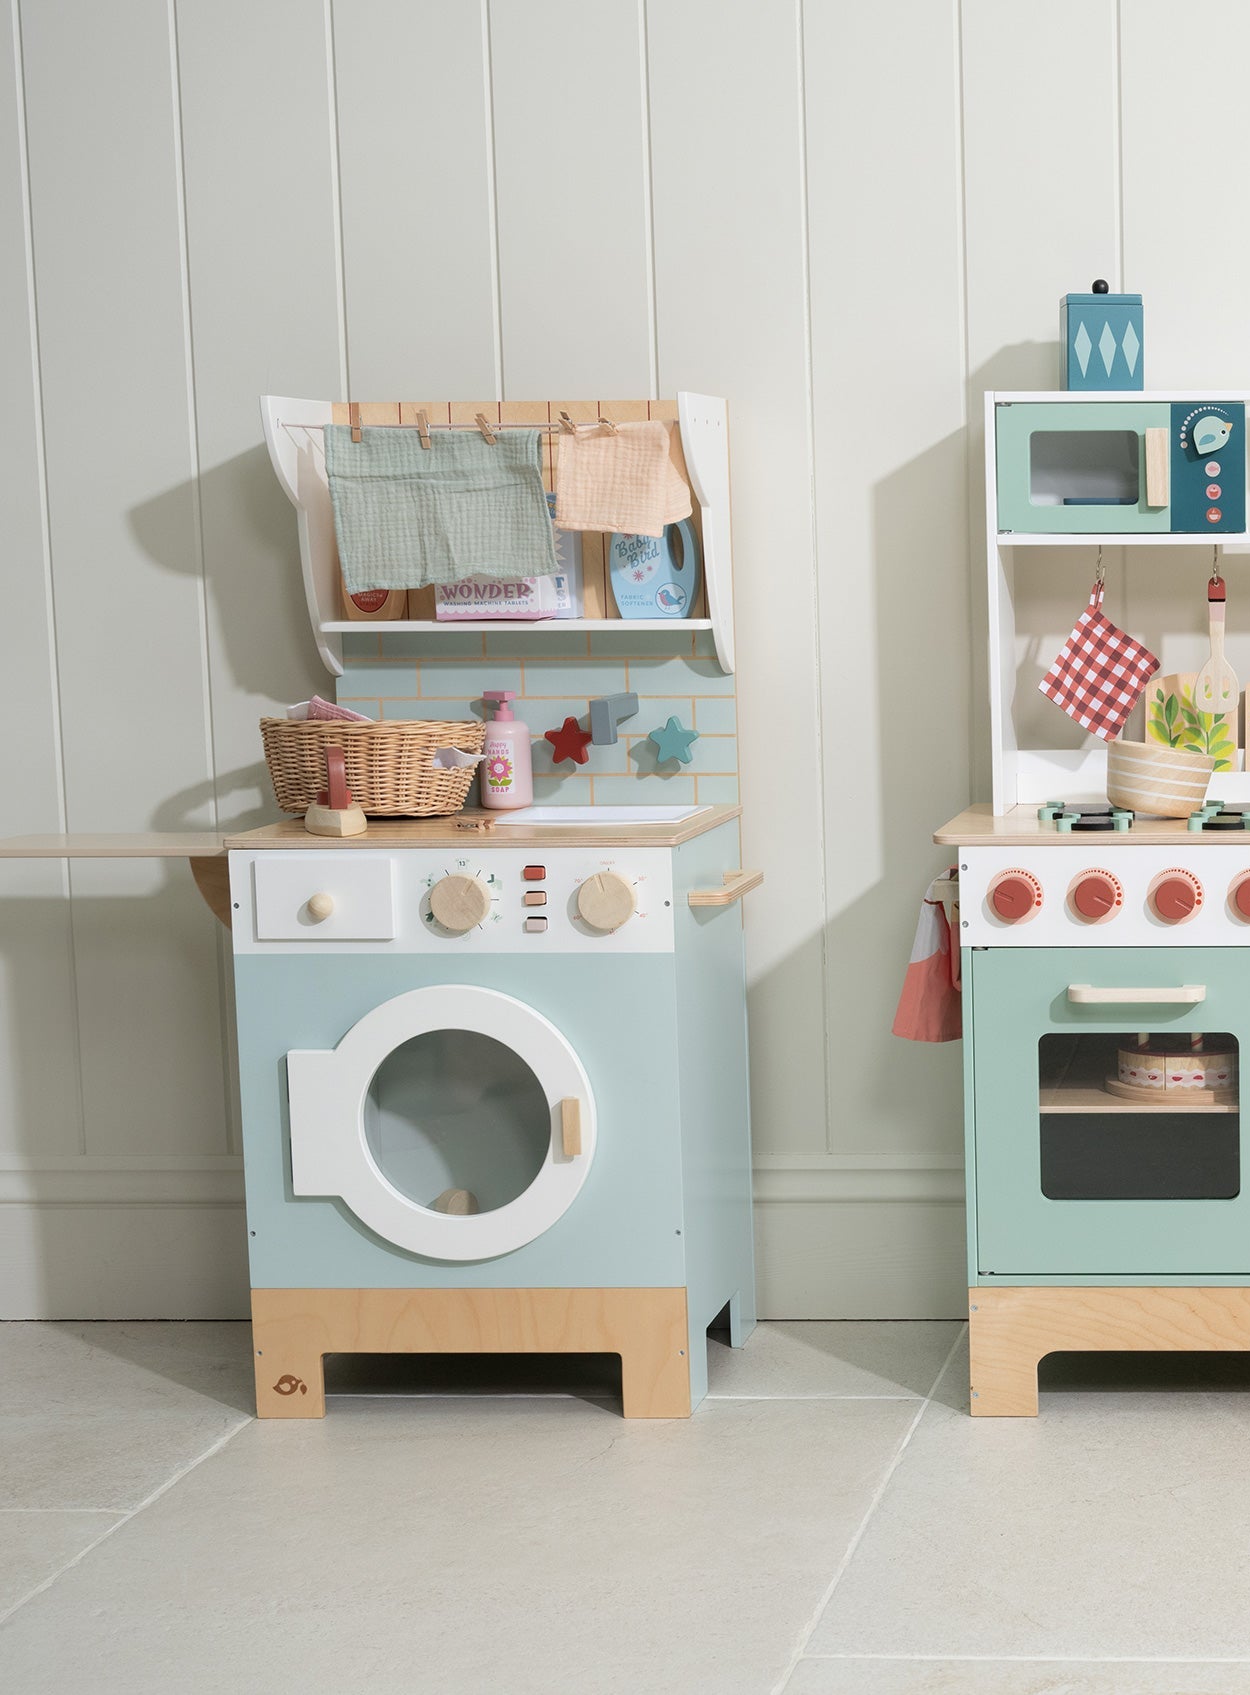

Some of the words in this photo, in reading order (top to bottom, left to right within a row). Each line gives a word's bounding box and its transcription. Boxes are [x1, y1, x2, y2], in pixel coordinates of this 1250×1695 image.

[615, 535, 651, 558] Baby
[627, 541, 660, 569] Bird
[441, 583, 532, 601] WONDER
